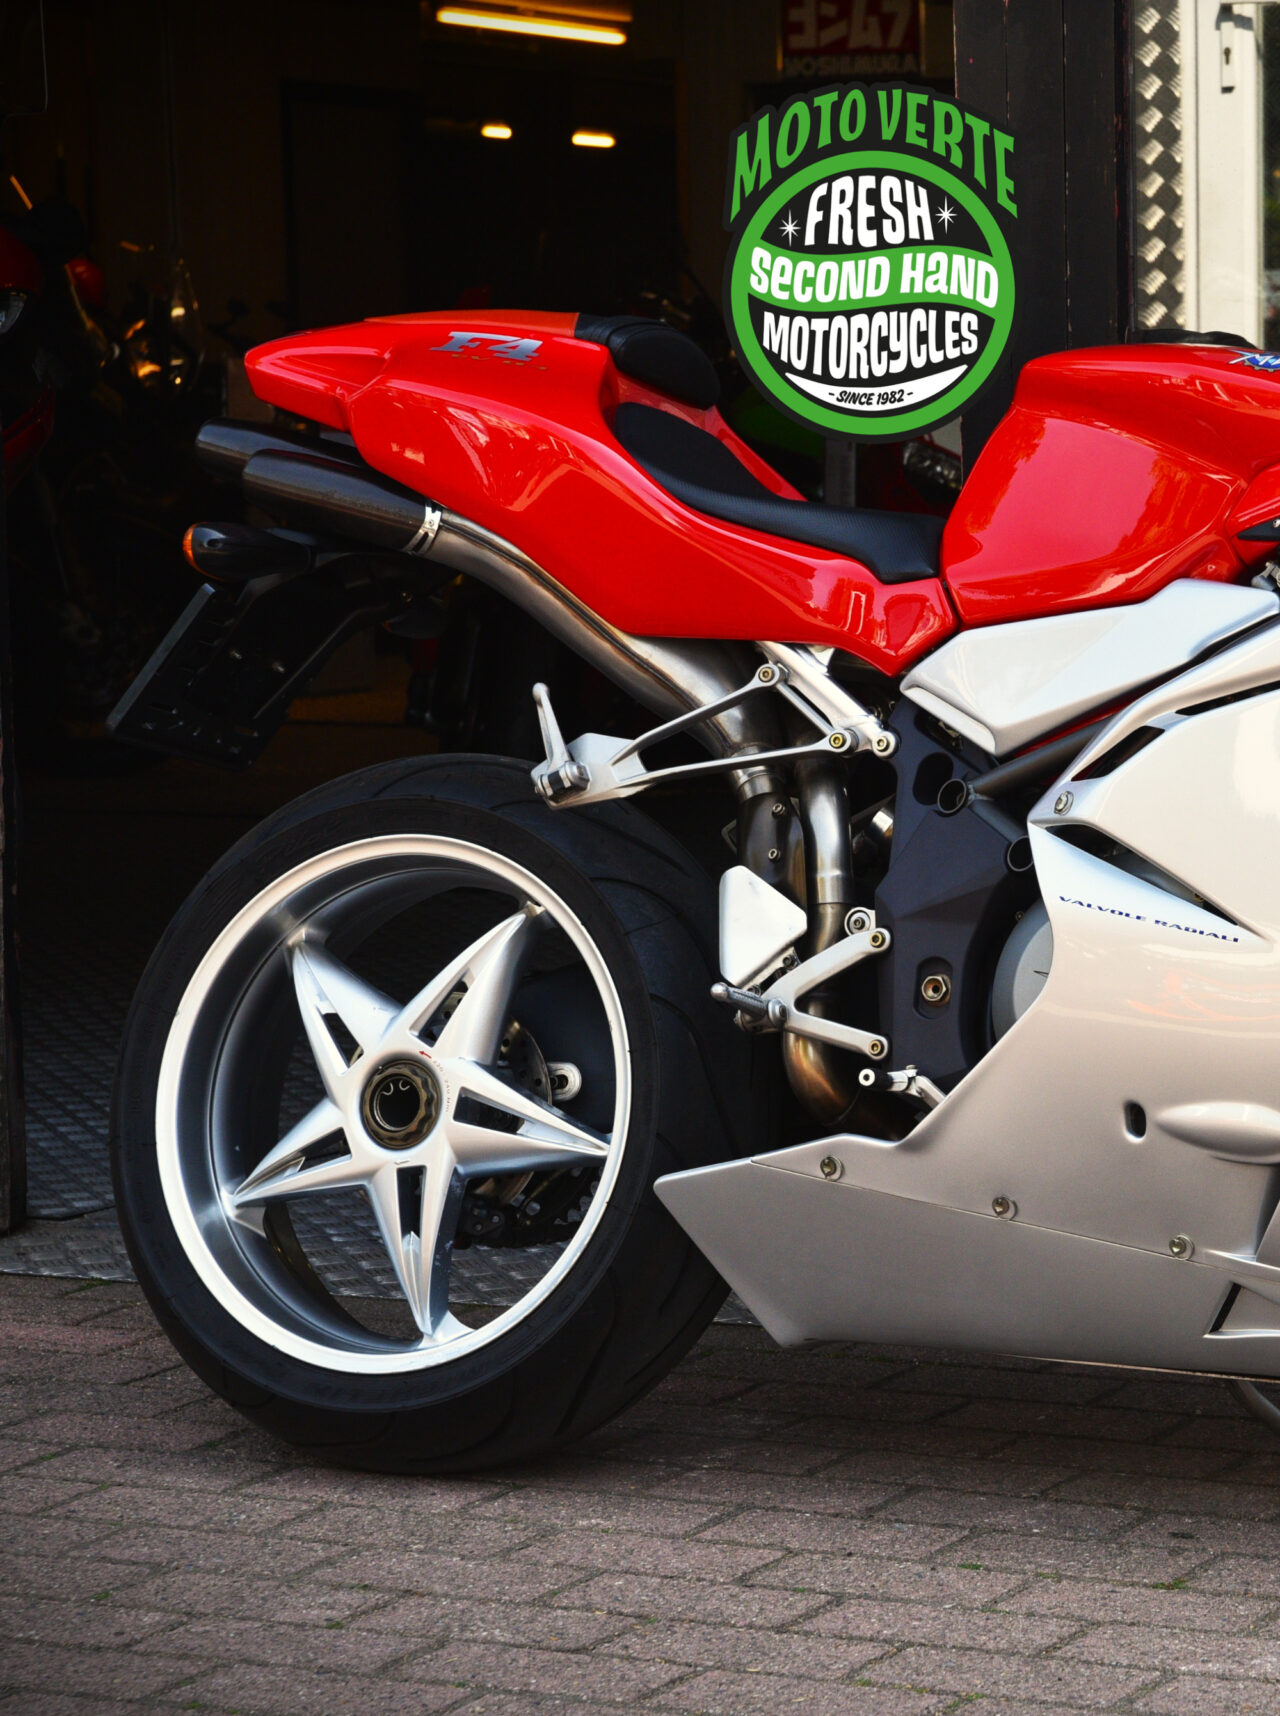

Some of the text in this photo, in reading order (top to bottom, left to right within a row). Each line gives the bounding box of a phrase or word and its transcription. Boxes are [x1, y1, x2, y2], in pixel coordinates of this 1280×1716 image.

[429, 331, 543, 361] F4
[1059, 895, 1239, 943] VALVOLE RADIALI
